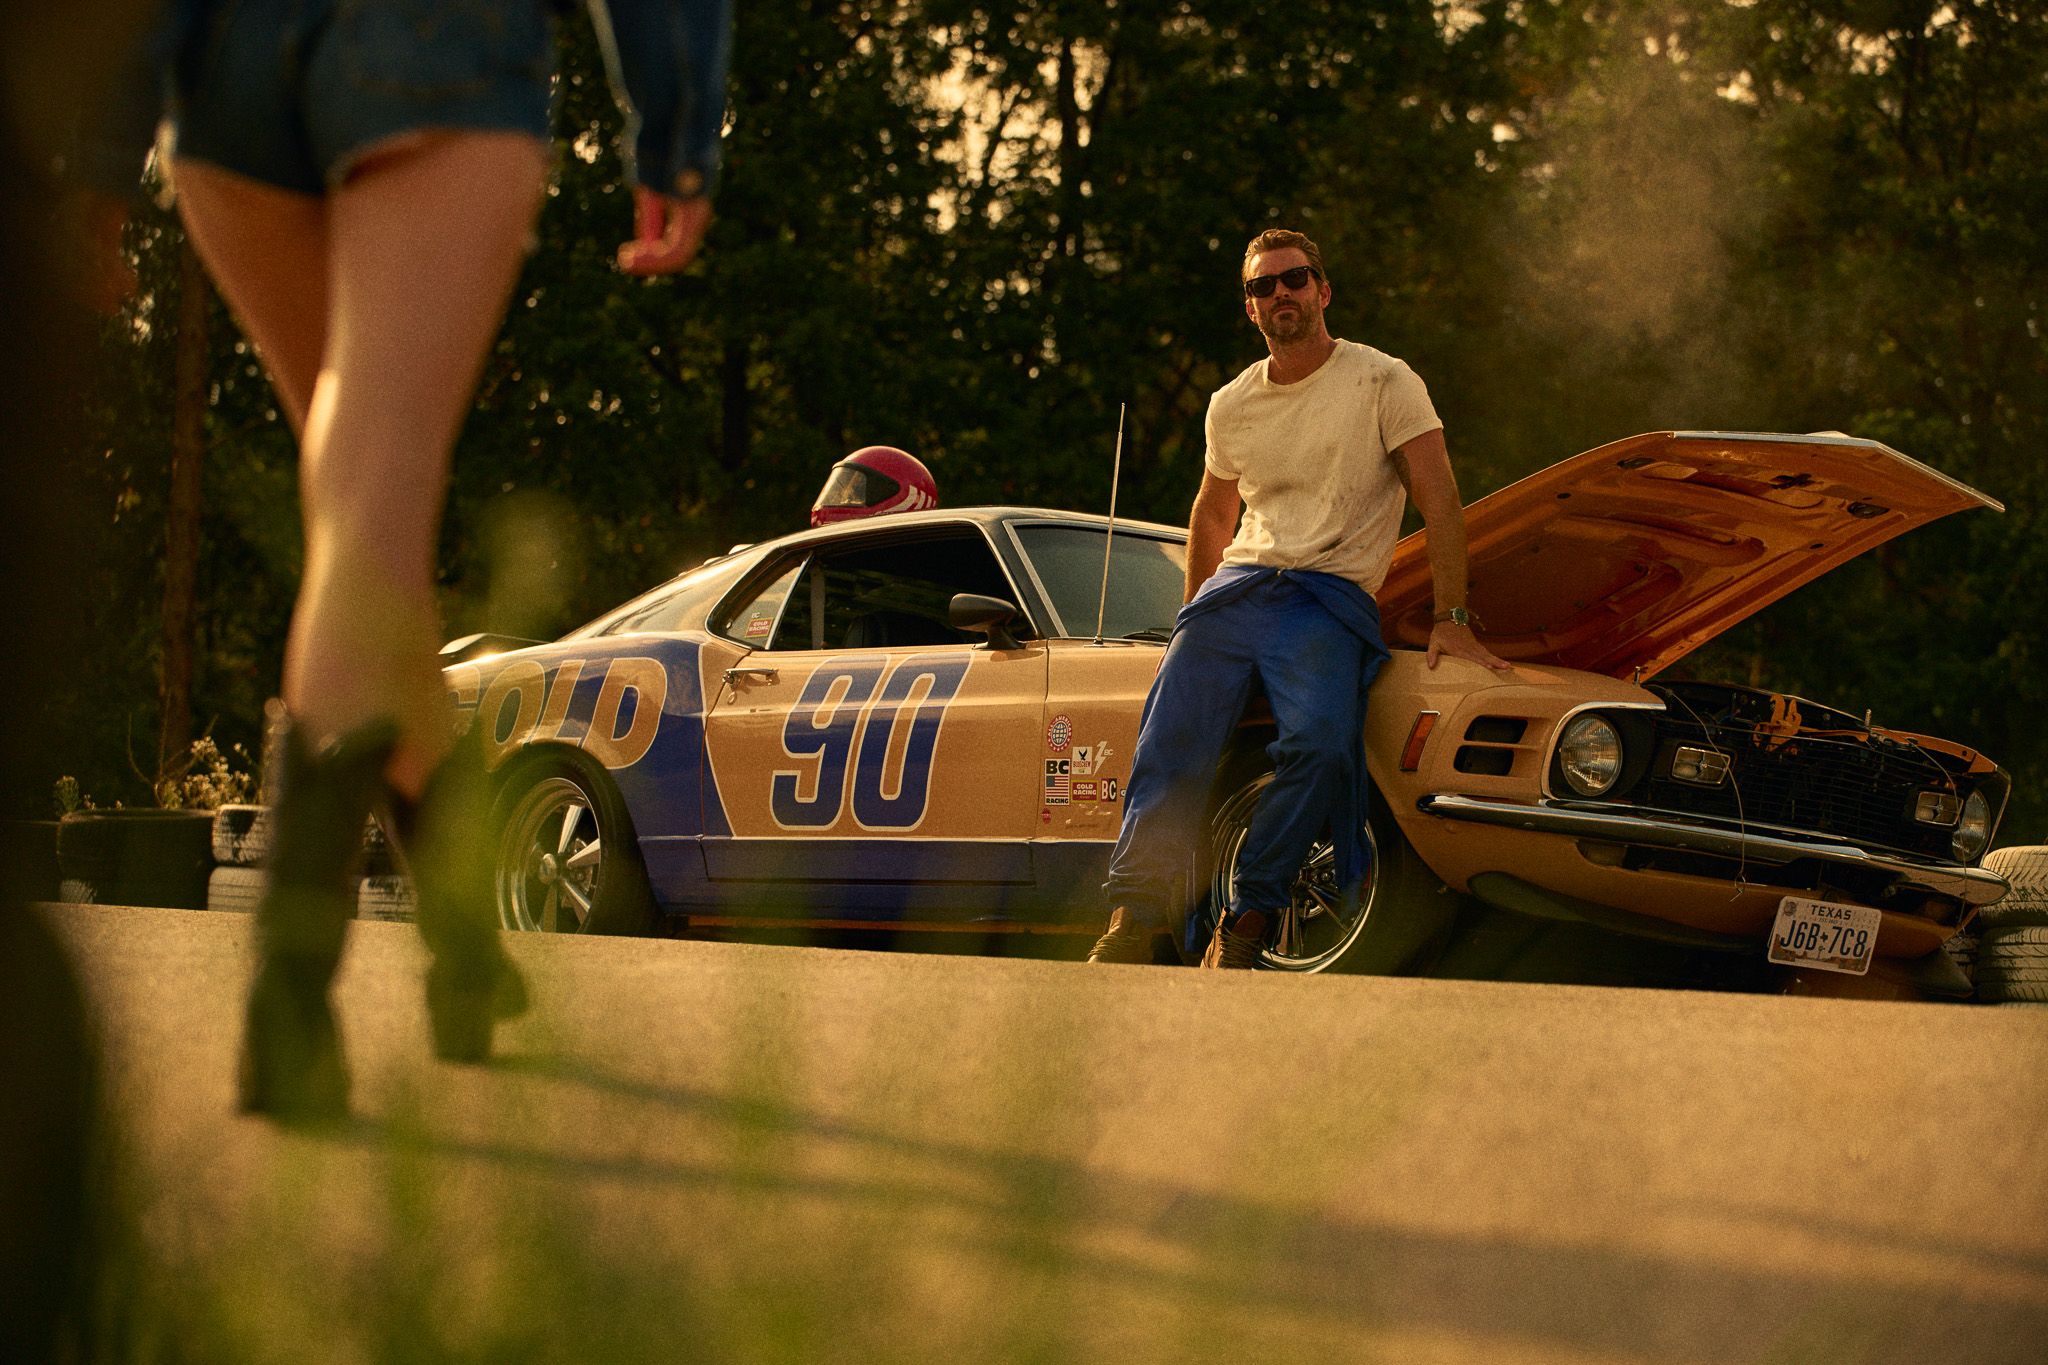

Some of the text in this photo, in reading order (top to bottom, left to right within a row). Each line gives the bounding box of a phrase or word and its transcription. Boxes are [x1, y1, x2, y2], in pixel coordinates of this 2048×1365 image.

[769, 652, 976, 832] 90
[1046, 760, 1069, 774] BC
[1101, 780, 1117, 800] BC
[1811, 904, 1852, 920] TEXAS
